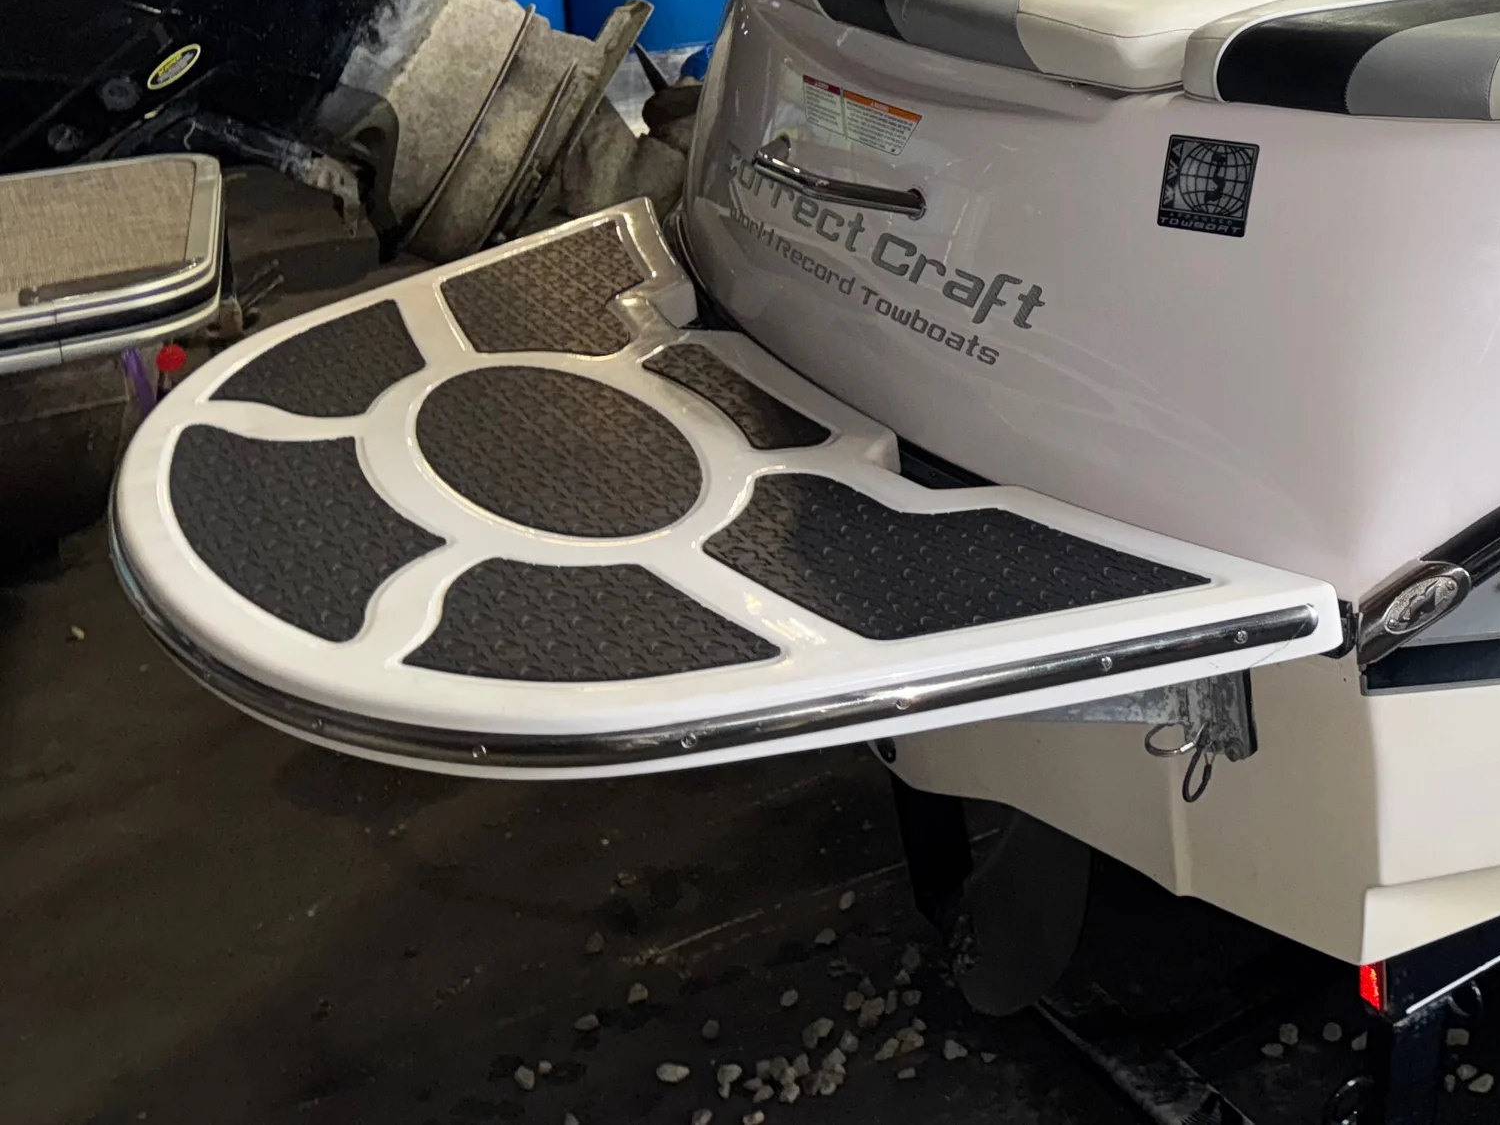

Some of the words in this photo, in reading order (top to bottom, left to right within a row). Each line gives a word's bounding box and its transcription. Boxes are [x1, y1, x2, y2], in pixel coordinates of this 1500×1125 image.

[1159, 216, 1242, 234] TOWBOAT
[775, 237, 857, 297] Record
[861, 285, 1001, 367] Towboats
[871, 230, 1046, 330] Craft
